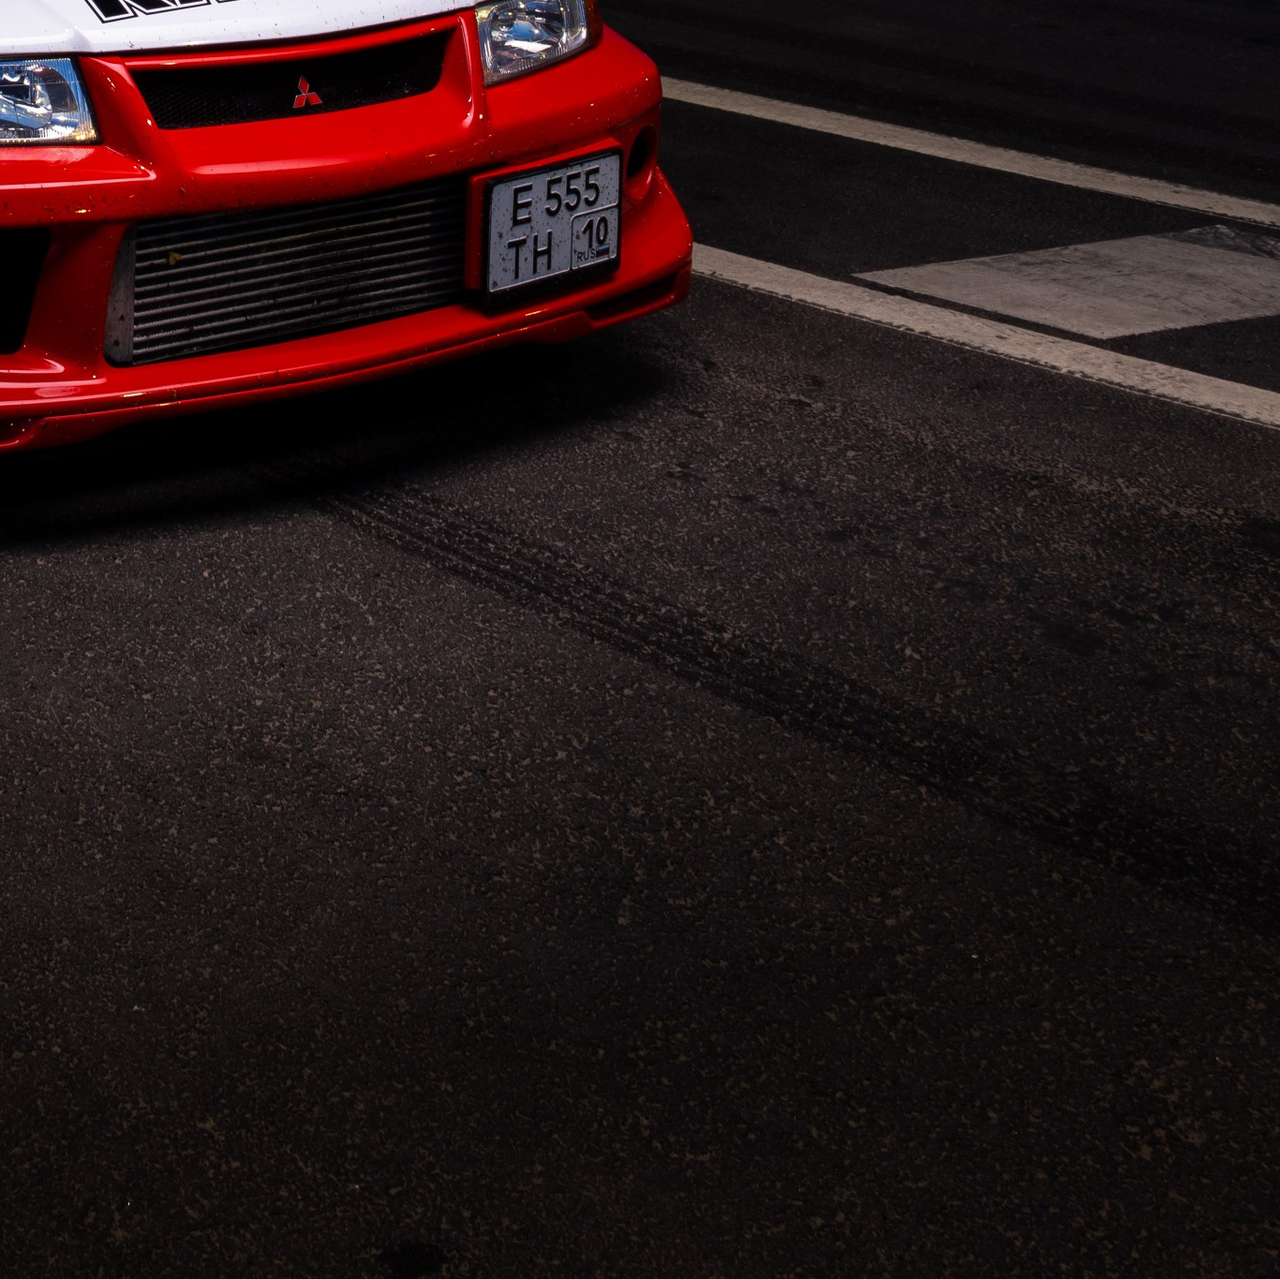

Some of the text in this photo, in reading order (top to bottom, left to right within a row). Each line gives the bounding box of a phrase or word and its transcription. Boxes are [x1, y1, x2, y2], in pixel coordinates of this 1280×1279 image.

[545, 165, 600, 217] 555
[581, 215, 609, 249] 10
[576, 249, 596, 264] RUS
